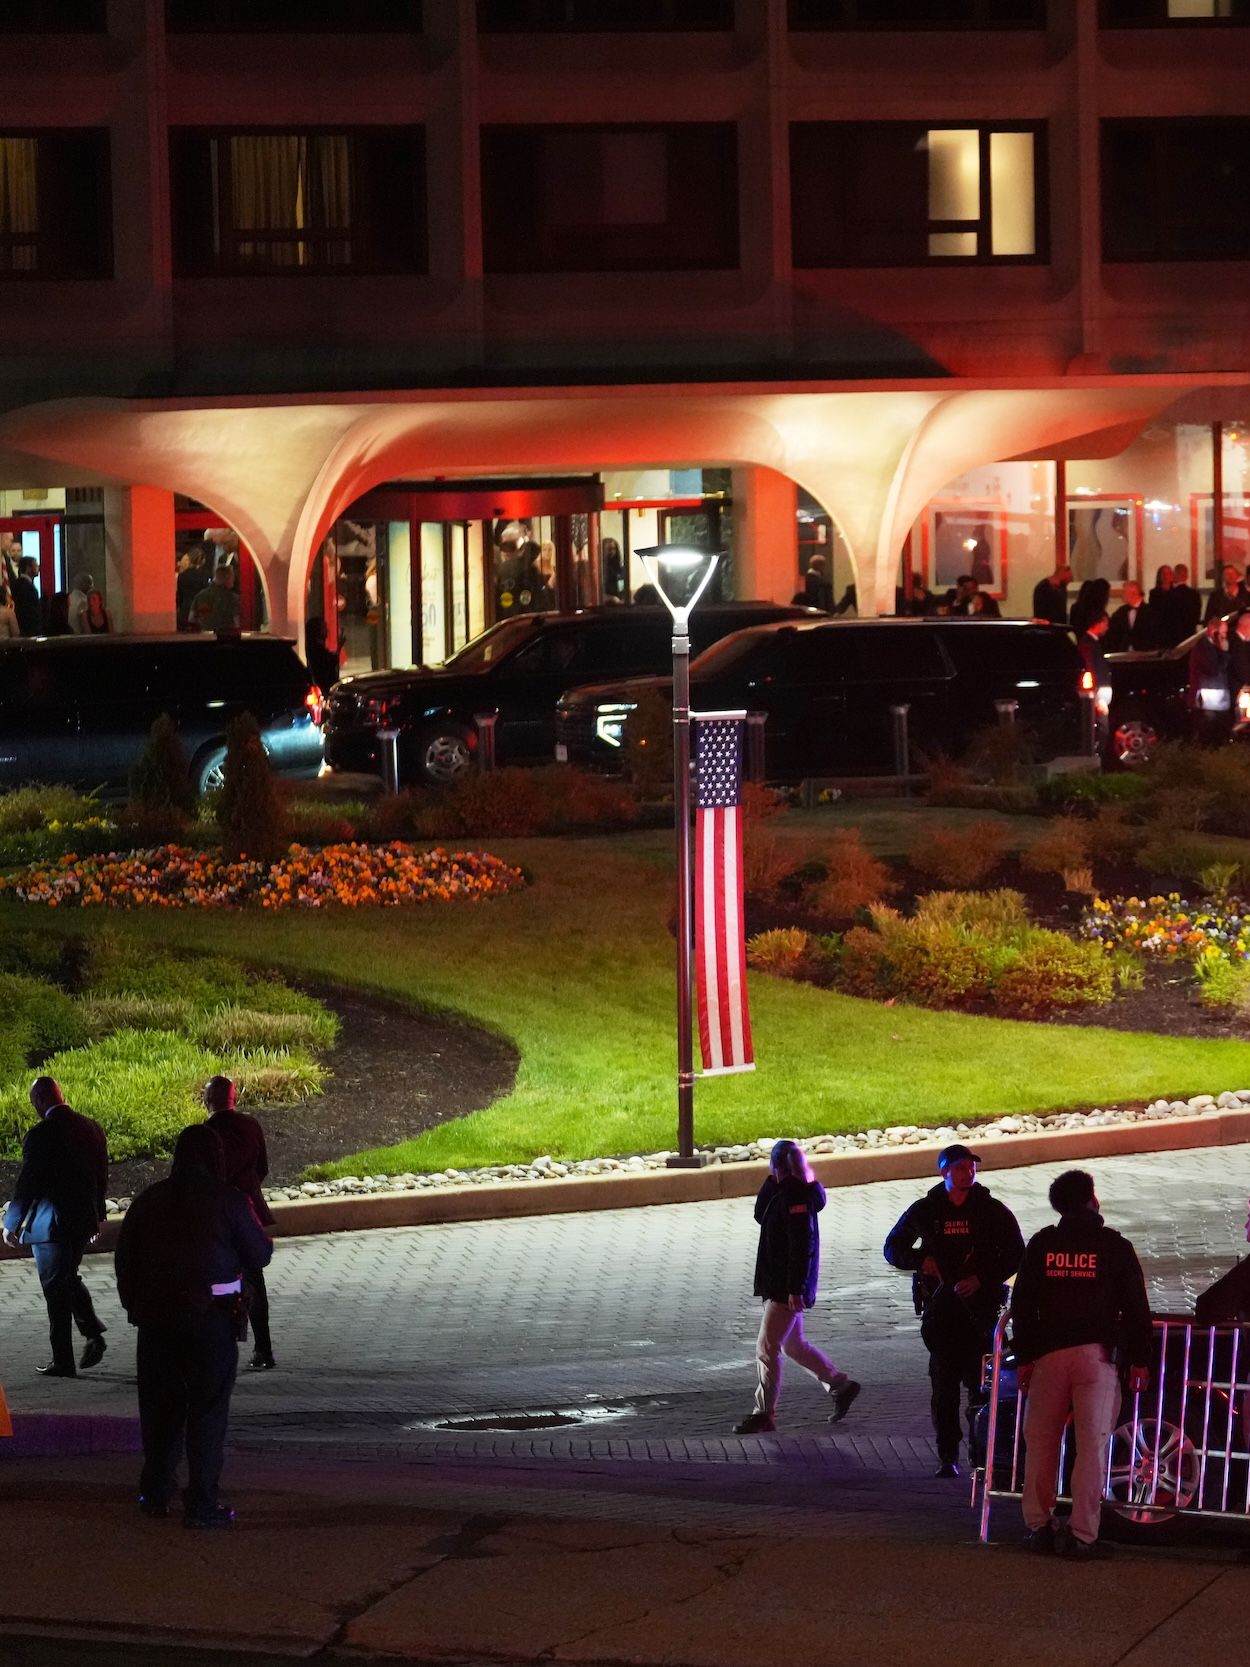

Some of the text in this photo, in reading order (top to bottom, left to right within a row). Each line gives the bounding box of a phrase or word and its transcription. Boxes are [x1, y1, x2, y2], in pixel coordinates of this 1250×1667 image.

[1046, 1252, 1097, 1269] POLICE
[1046, 1270, 1097, 1279] SECRET SERVICE
